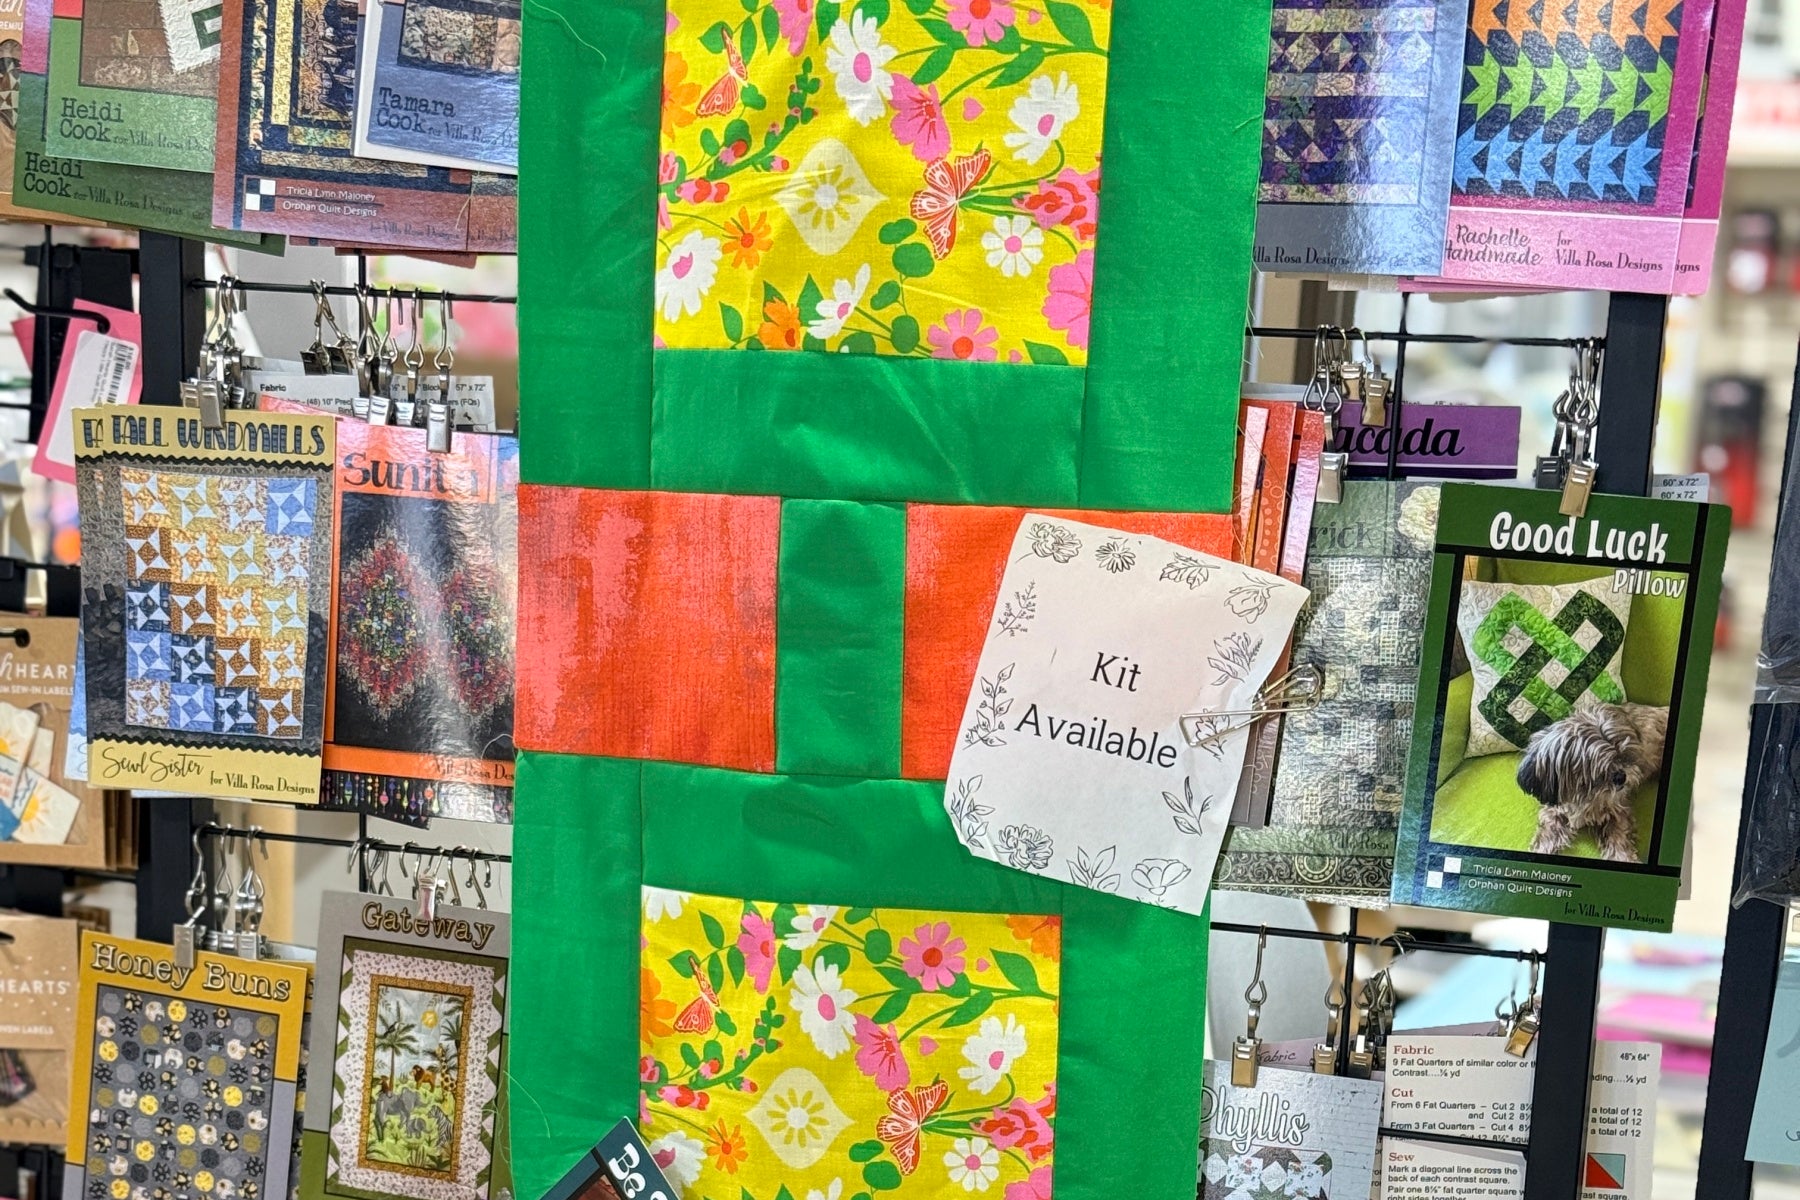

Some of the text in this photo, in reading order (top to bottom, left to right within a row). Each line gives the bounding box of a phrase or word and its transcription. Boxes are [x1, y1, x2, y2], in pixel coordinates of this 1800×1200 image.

[61, 97, 124, 123] Heidi
[378, 86, 456, 117] Tamara
[60, 120, 111, 142] Cook
[376, 108, 468, 140] Cook Villa
[25, 152, 83, 179] Heidi
[24, 173, 183, 217] Cook Villa Rosa Designs
[286, 186, 376, 203] Tricia Lynn Maloney
[282, 201, 377, 217] Orphan Quilt Designs
[1456, 224, 1572, 247] Rachelle for
[1274, 247, 1350, 267] Rosa Designs
[1556, 251, 1580, 266] Villa
[1586, 251, 1612, 268] Rosa
[1617, 253, 1663, 272] Designs
[260, 383, 287, 392] Fabric
[111, 415, 326, 457] FALL WINDMILLS
[1662, 478, 1700, 487] 60" 72"
[1490, 512, 1669, 564] Good Luck
[1612, 568, 1686, 598] Pillow
[1090, 652, 1142, 693] Kit
[1014, 703, 1178, 768] Available
[150, 750, 212, 783] Sister
[210, 770, 316, 796] for Villa Rosa Designs
[1474, 864, 1572, 884] Tricia Lynn Maloney
[1468, 878, 1573, 898] Orphan Quilt Designs
[1564, 902, 1665, 925] for Villa Rosa Designs
[362, 901, 496, 950] Gateway
[91, 943, 290, 1001] Honey Buns
[1393, 1045, 1434, 1055] Fabric
[1416, 1058, 1494, 1067] Quarters similar
[1392, 1088, 1414, 1098] Cut
[1391, 1101, 1413, 1109] From
[1201, 1085, 1310, 1154] Phyllis
[1388, 1152, 1414, 1162] Sew
[608, 1142, 646, 1199] Be
[1420, 1166, 1454, 1176] diagonal
[1457, 1166, 1472, 1174] line
[1443, 1176, 1476, 1184] contrast
[1479, 1177, 1510, 1186] square.
[1456, 1187, 1517, 1196] quarter square
